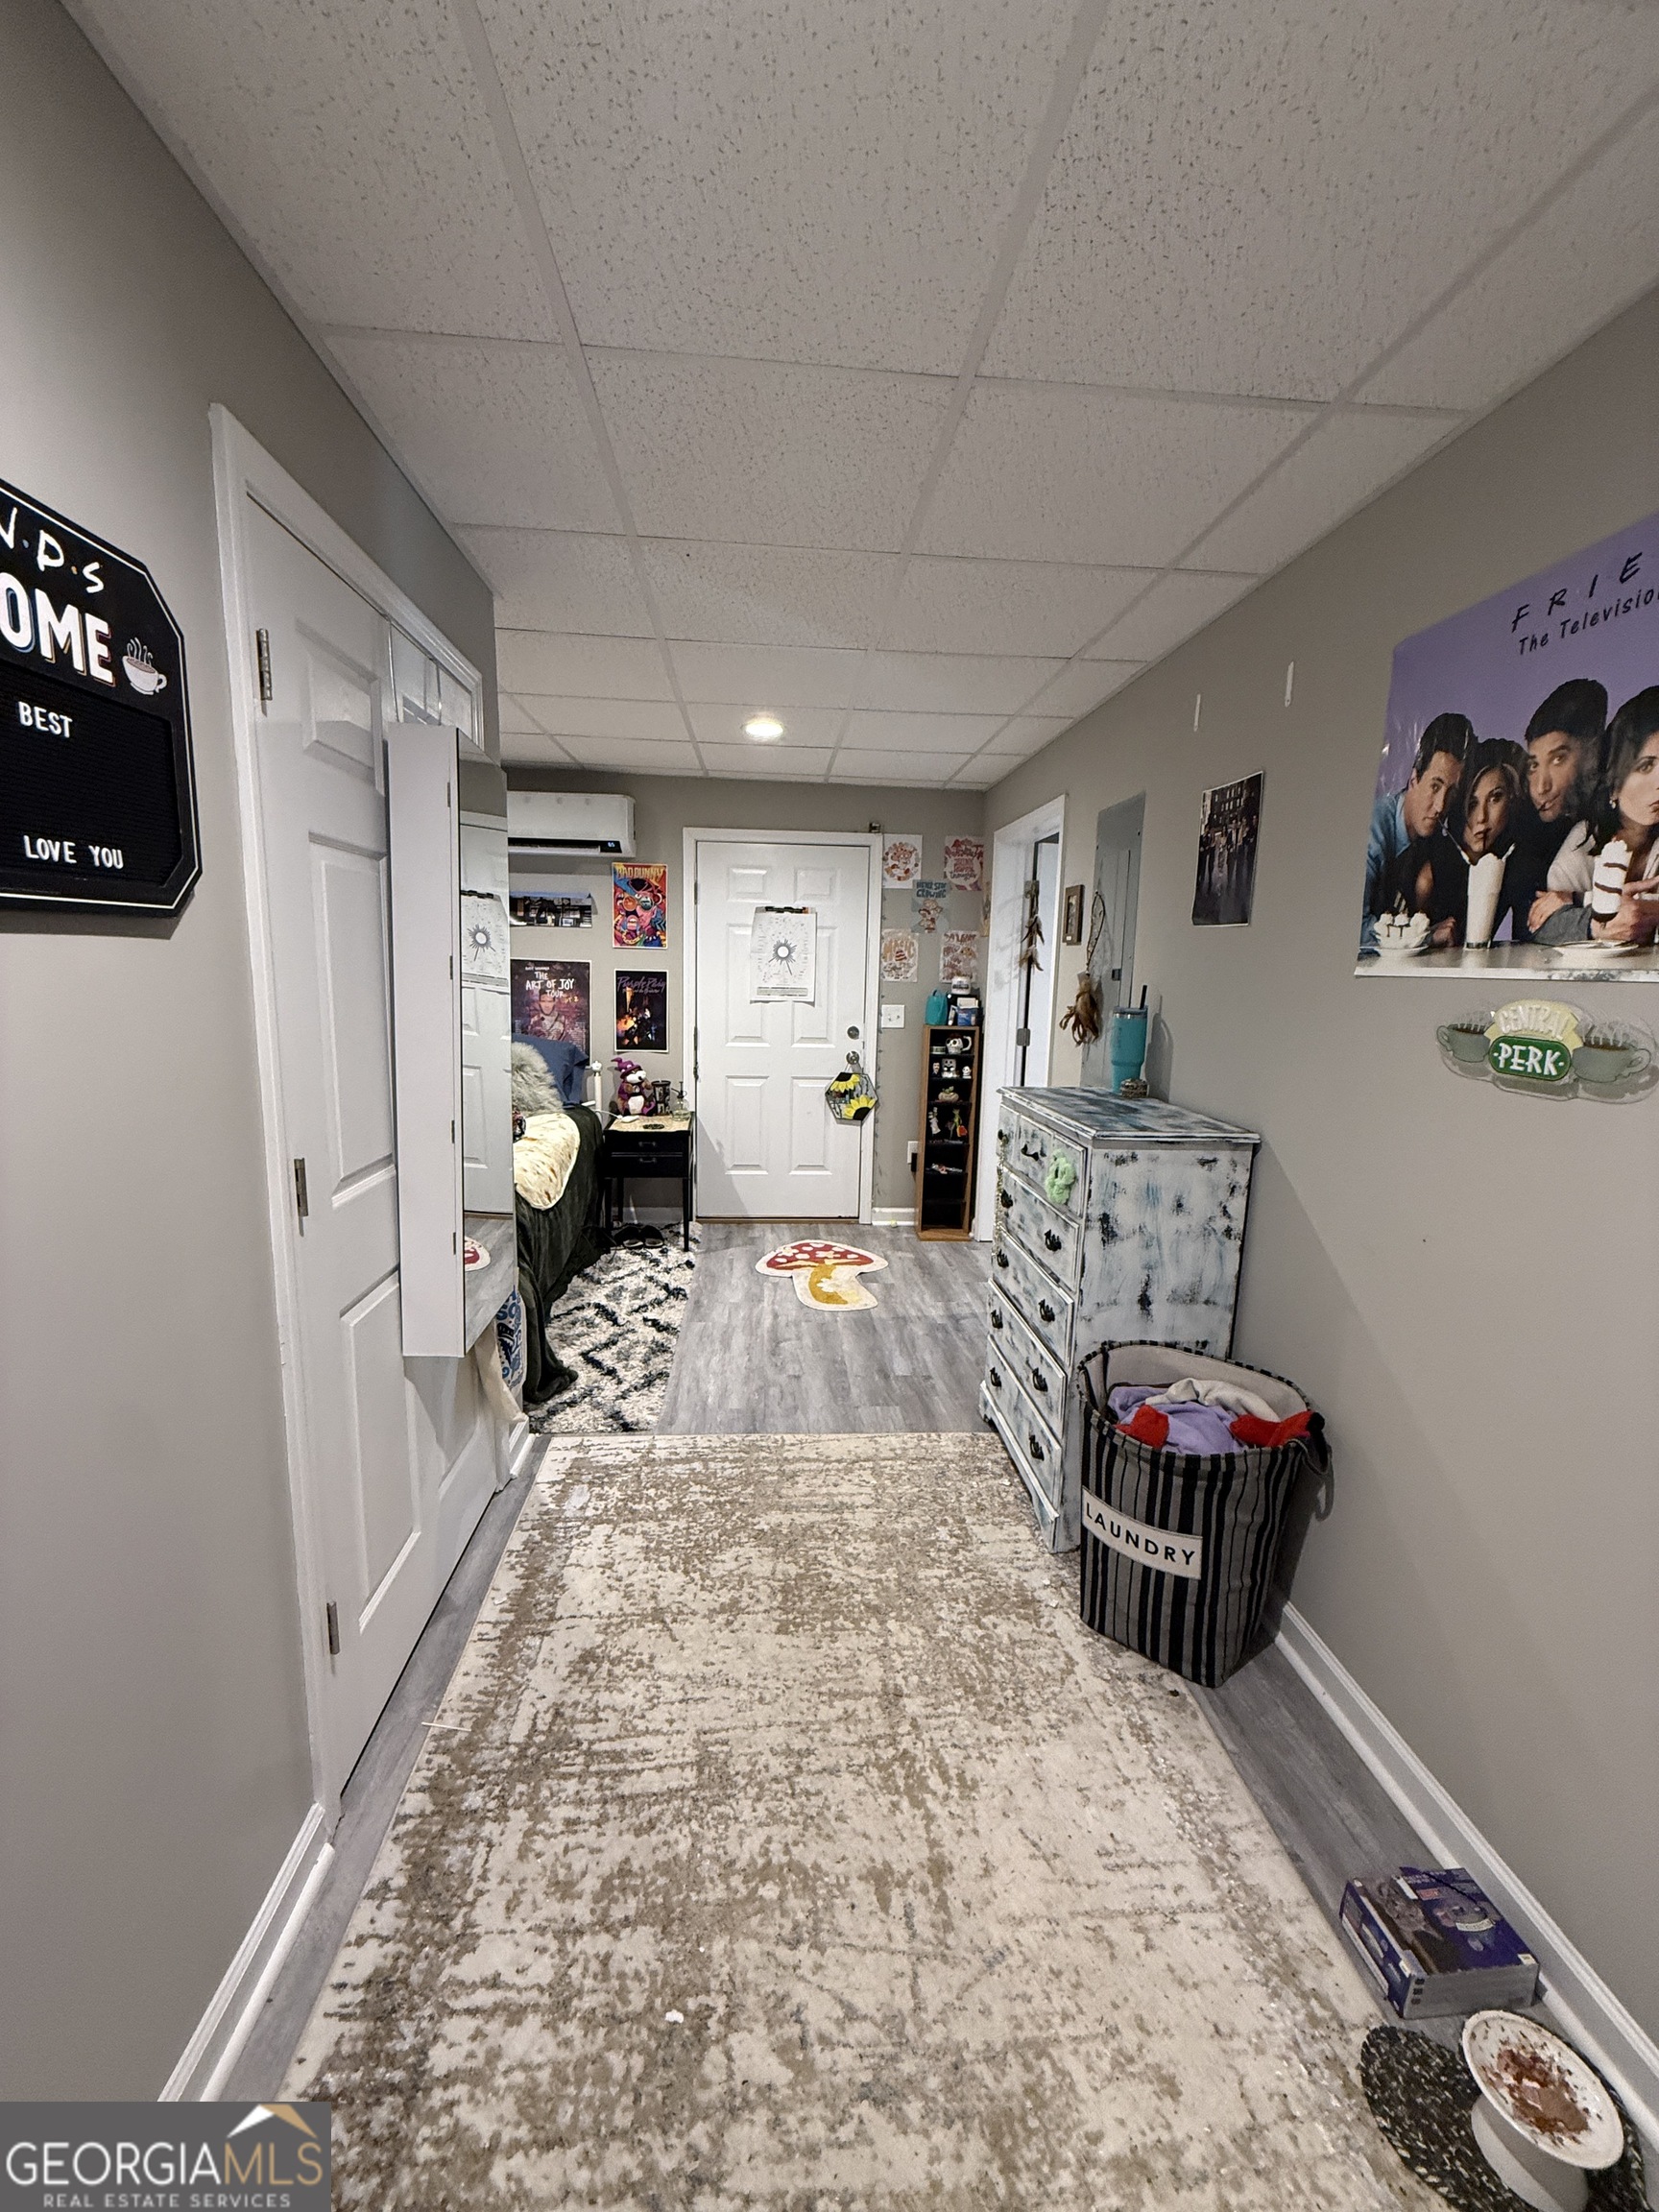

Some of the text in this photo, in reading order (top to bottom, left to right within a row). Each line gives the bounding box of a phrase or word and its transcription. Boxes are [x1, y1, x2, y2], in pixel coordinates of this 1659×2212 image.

[0, 571, 114, 685] OME
[1519, 589, 1659, 655] The Televisio
[18, 702, 72, 738] BEST
[23, 835, 124, 869] LOVE YOU
[525, 978, 574, 991] ART OF JOY
[545, 990, 564, 998] TOUR
[1499, 1003, 1570, 1041] CENTRAL
[1498, 1043, 1562, 1075] PERK
[1086, 1503, 1195, 1565] LAUNDRY
